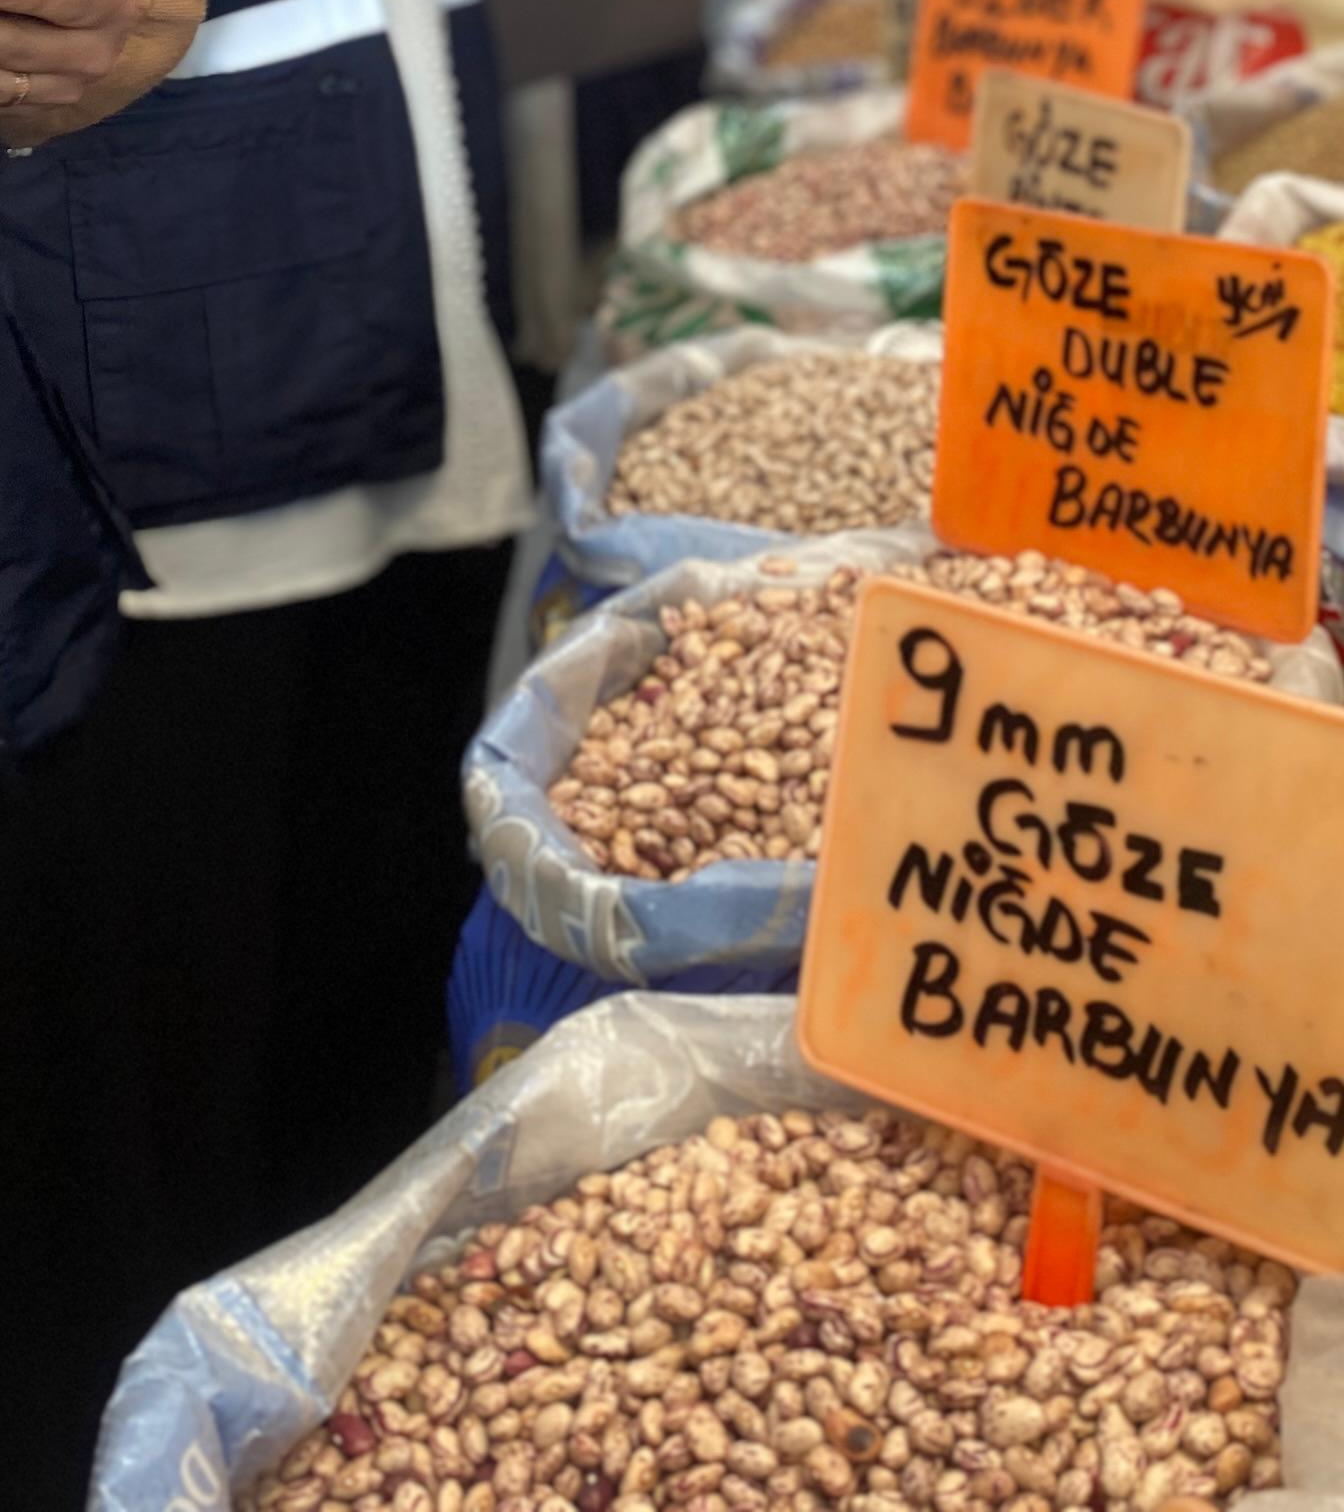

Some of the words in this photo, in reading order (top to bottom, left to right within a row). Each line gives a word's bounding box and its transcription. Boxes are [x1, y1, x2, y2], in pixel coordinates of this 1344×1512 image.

[983, 233, 1132, 321] GÖZE
[1061, 326, 1232, 408] DUBLE
[1047, 464, 1296, 582] BARBUNYA
[976, 778, 1226, 919] GÖZE
